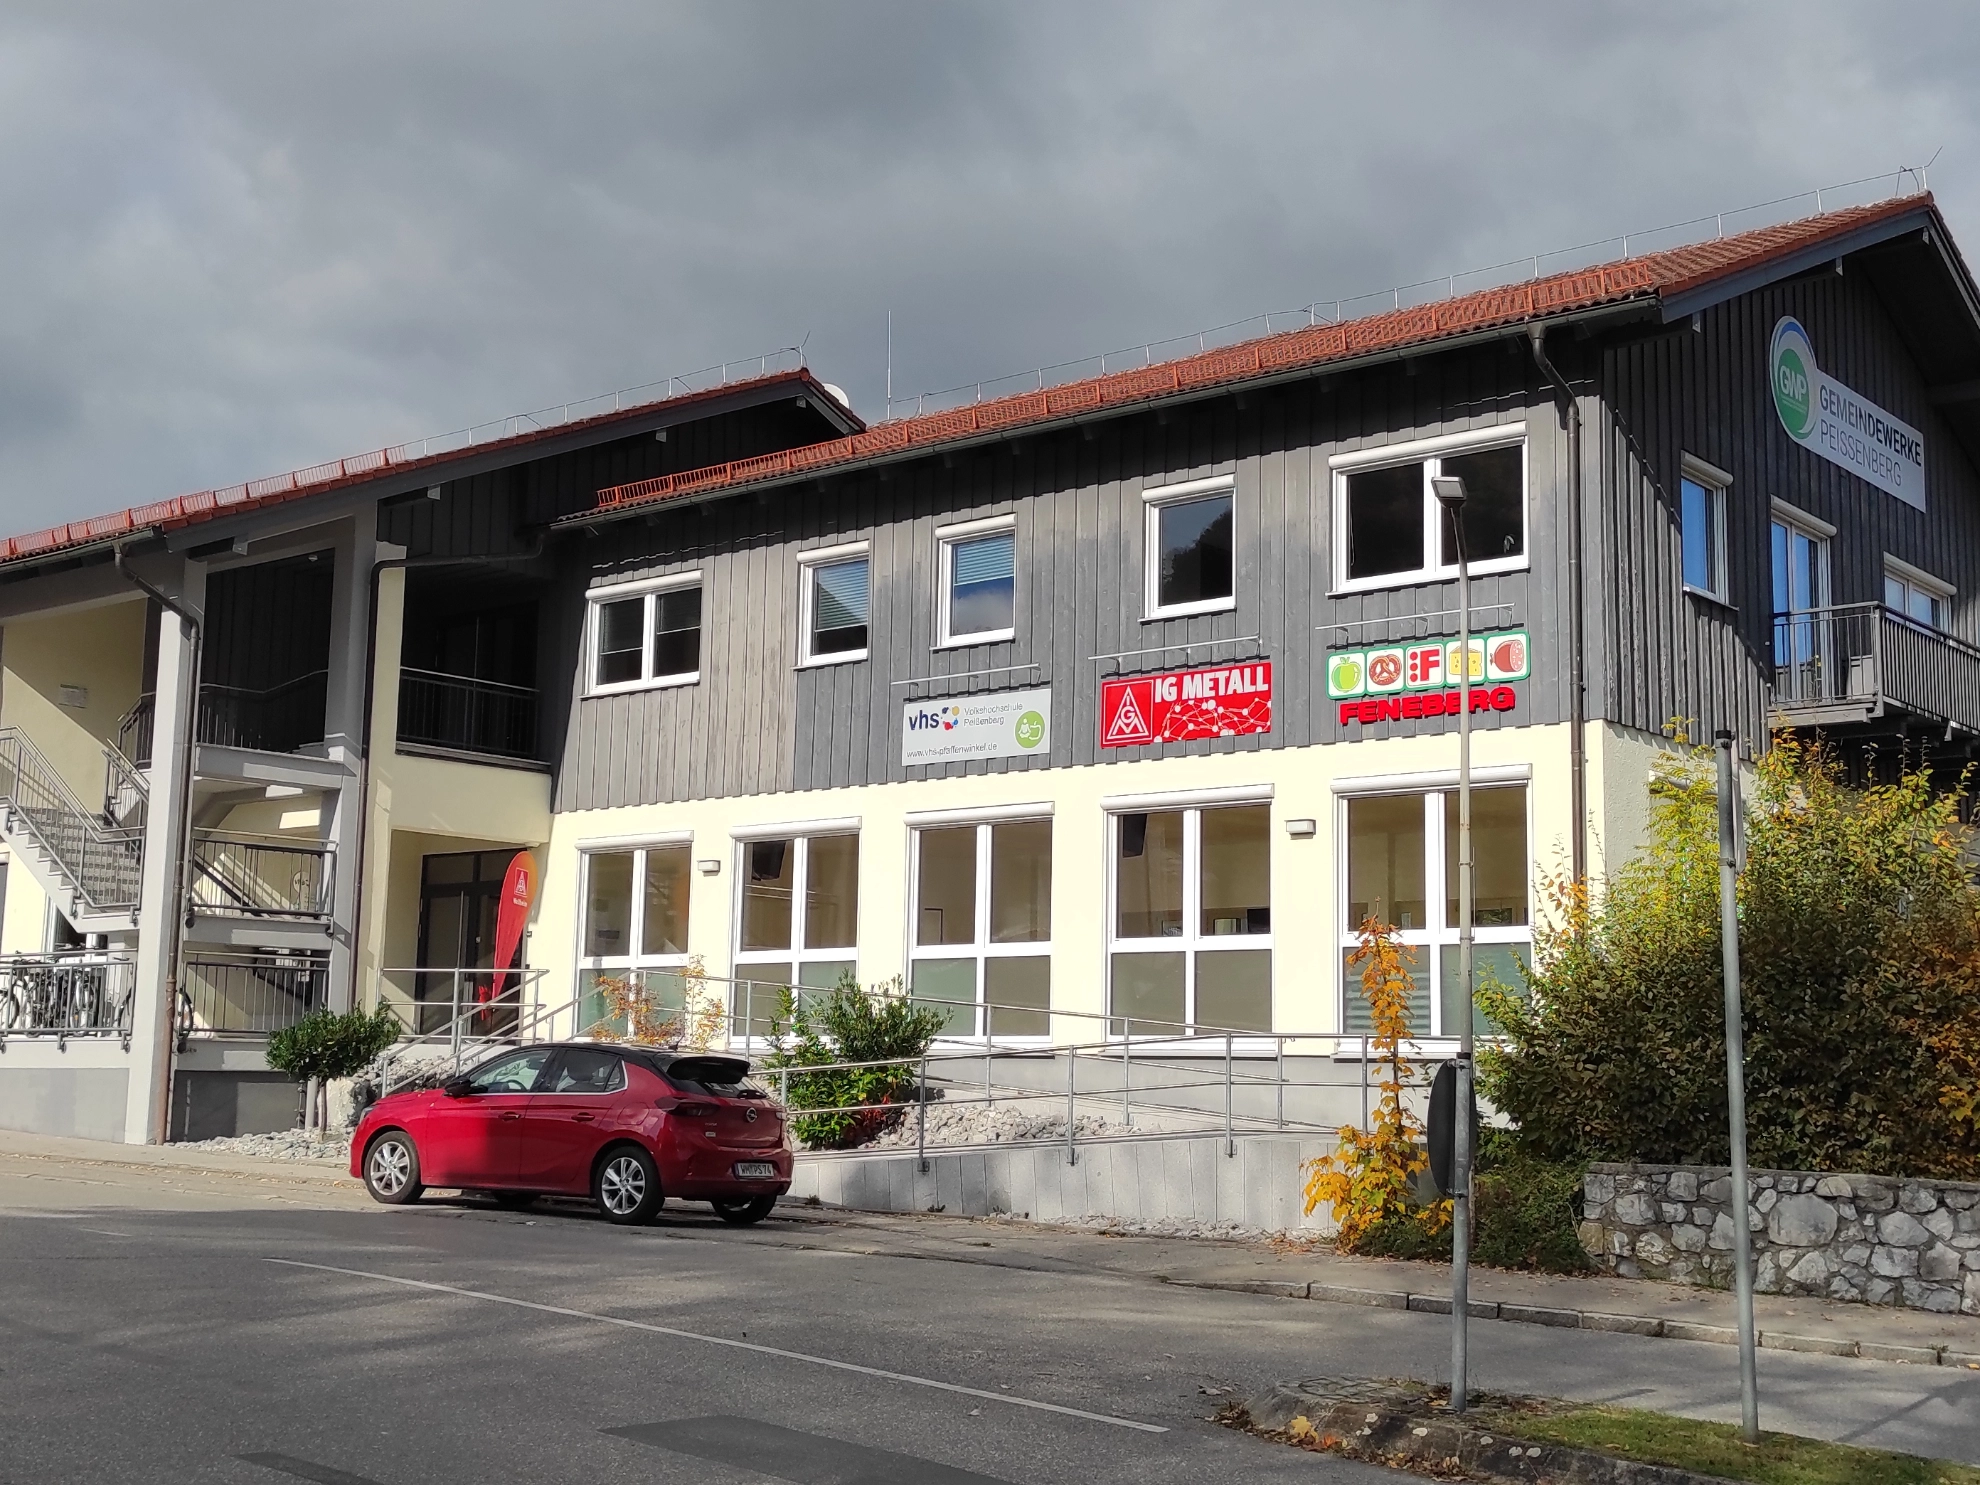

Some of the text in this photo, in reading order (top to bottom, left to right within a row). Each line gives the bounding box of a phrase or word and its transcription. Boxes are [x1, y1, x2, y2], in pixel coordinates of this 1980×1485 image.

[1780, 365, 1807, 402] GWP
[1819, 384, 1922, 468] GEMEINDEWERKE
[1820, 419, 1902, 486] PEISSENBERG
[1154, 665, 1269, 703] IG METALL
[908, 709, 940, 731] vhs
[1340, 687, 1515, 725] FENEBERG
